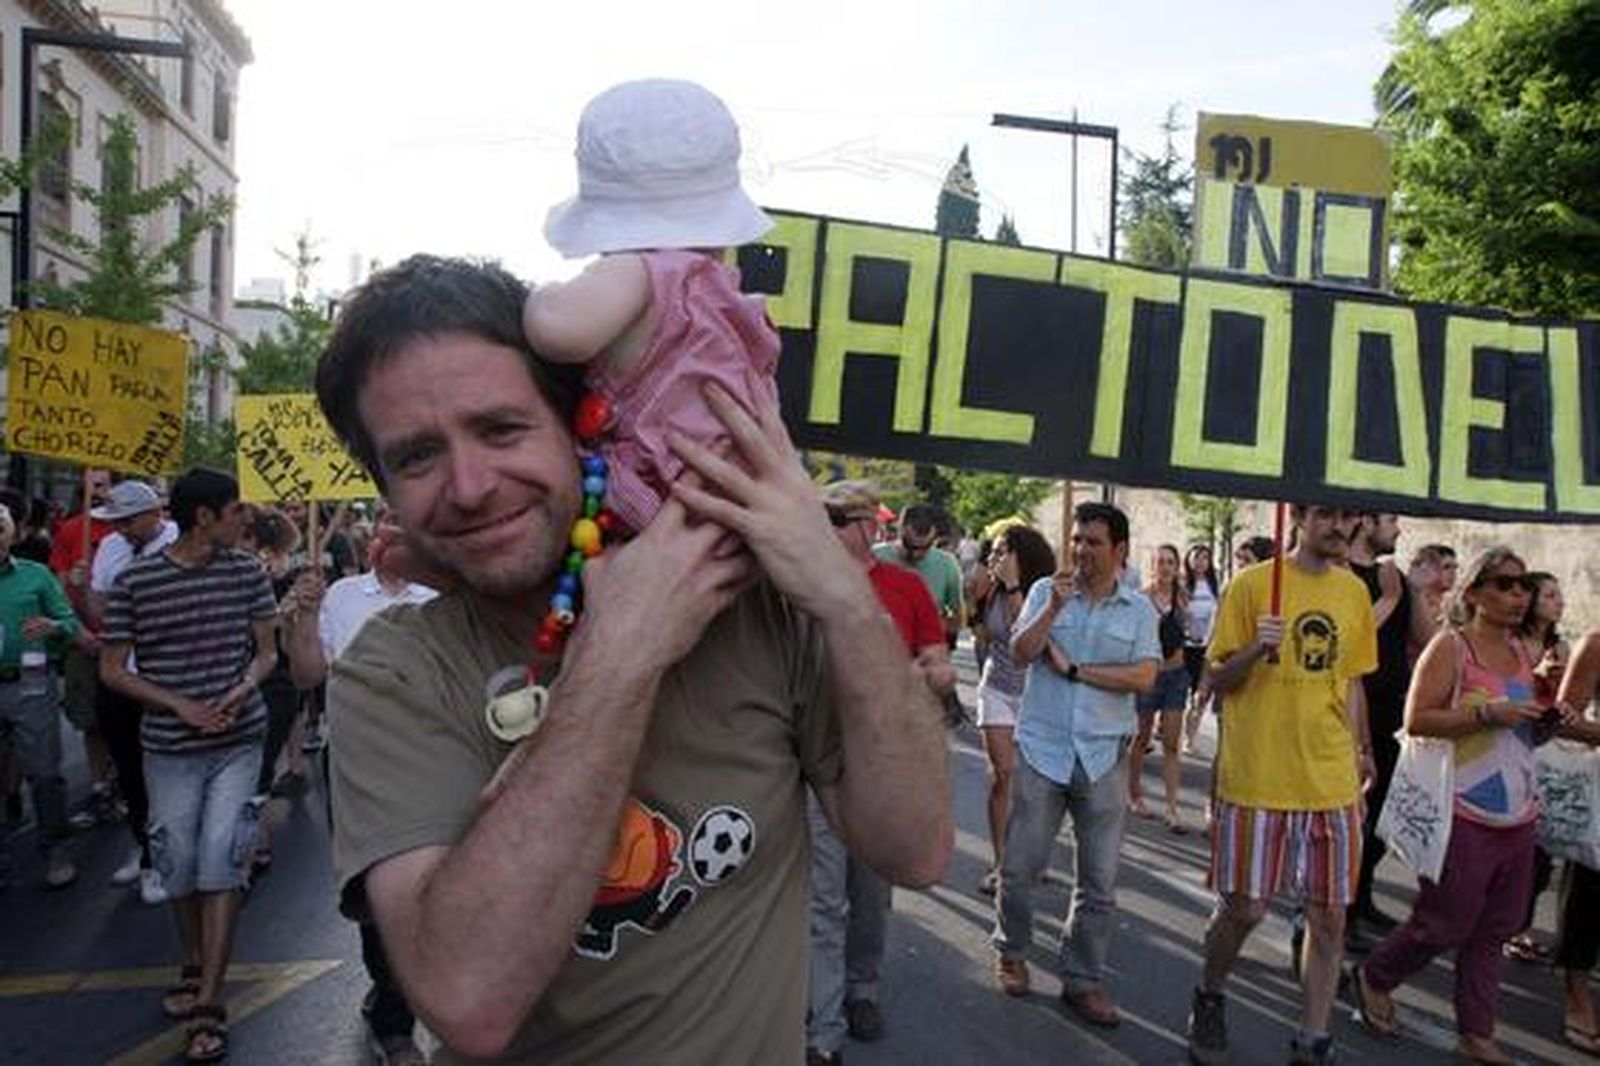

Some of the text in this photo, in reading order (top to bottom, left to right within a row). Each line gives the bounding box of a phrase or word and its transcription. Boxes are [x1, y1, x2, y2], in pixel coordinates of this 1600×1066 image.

[1228, 183, 1386, 288] NO
[20, 318, 141, 367] NO HAY
[724, 214, 1600, 514] PACTO DEL
[19, 356, 90, 397] PAN
[14, 398, 96, 429] TANTO
[329, 462, 369, 486] YA
